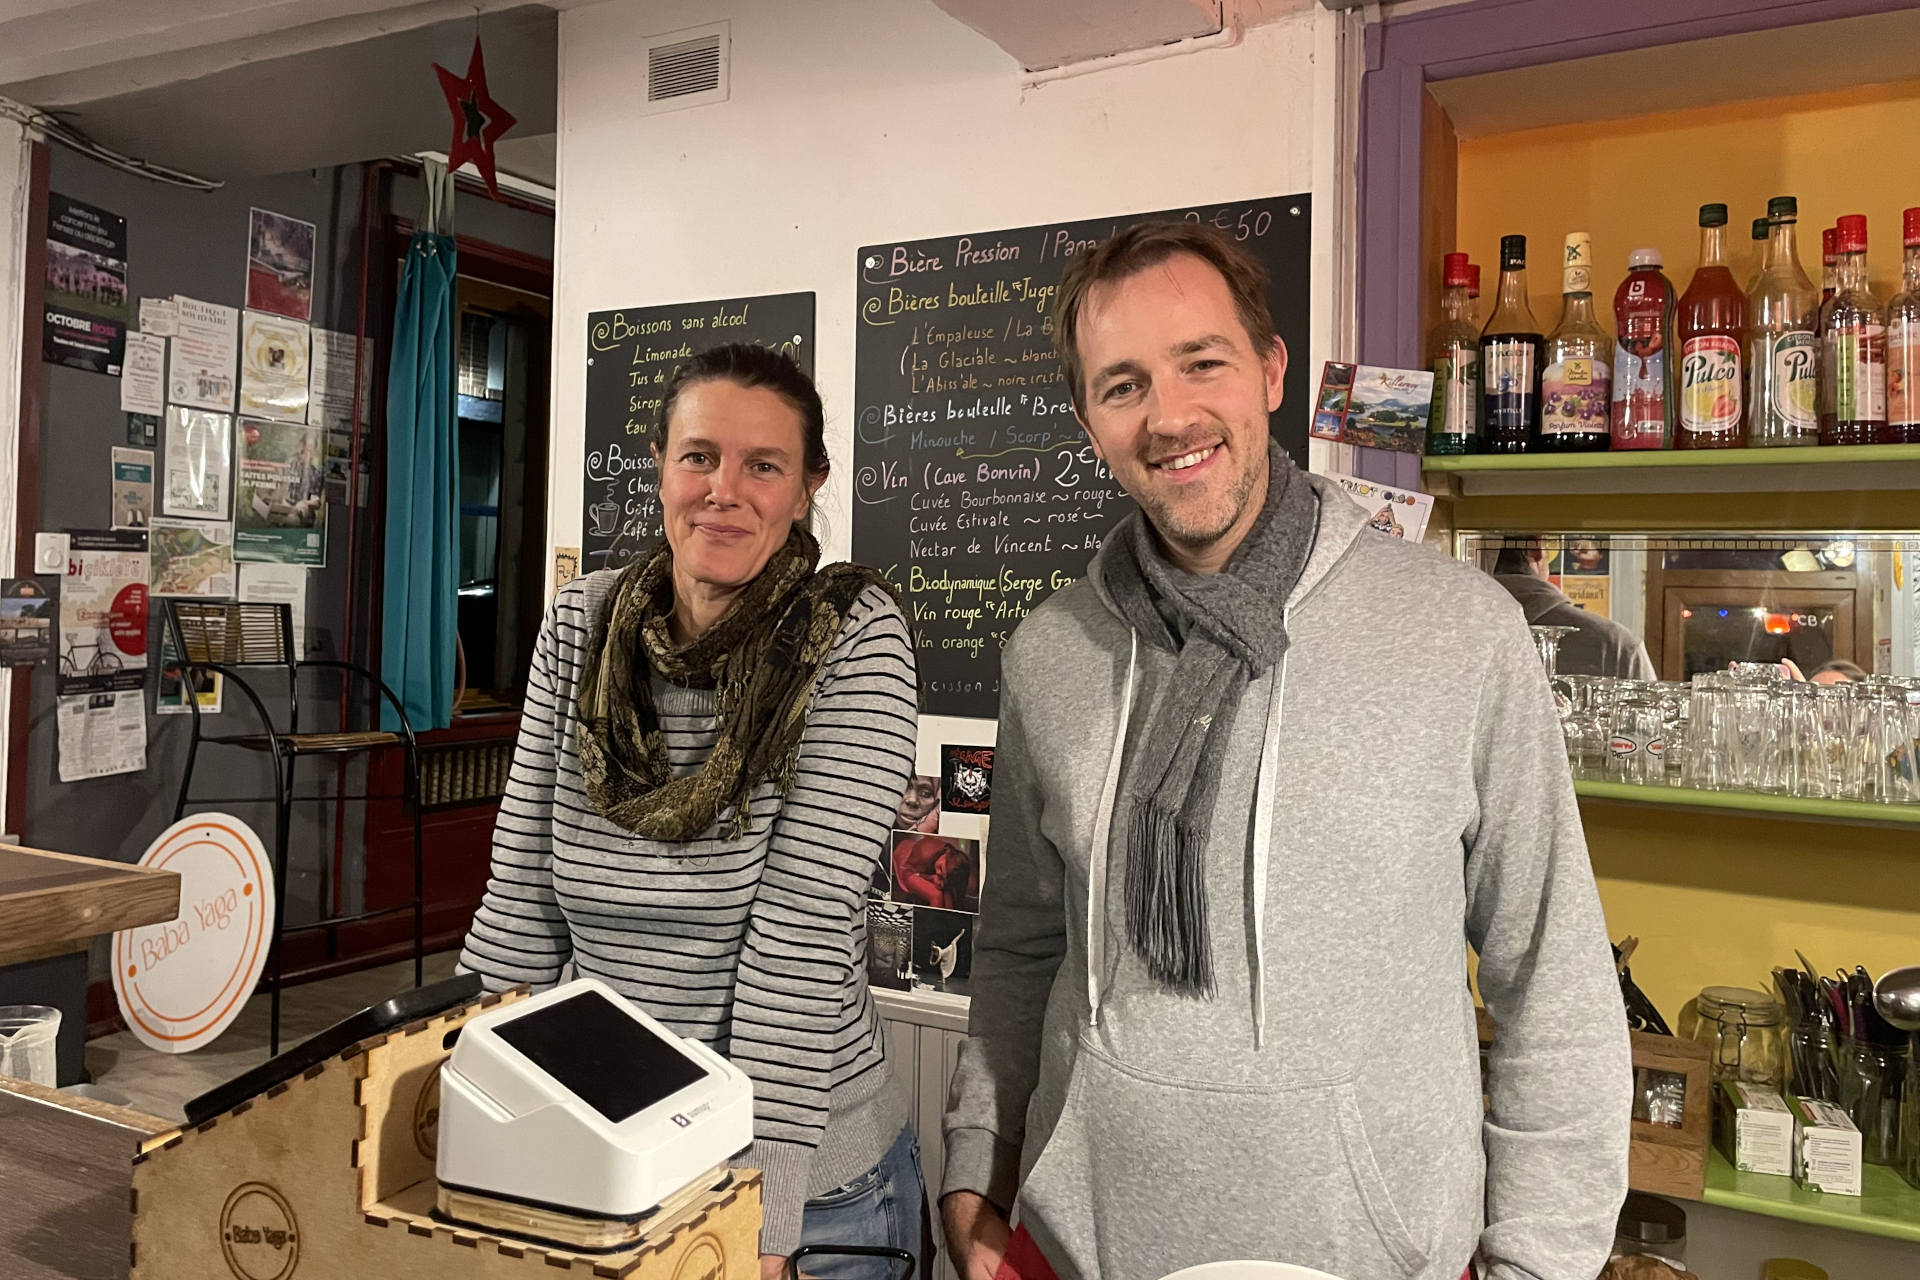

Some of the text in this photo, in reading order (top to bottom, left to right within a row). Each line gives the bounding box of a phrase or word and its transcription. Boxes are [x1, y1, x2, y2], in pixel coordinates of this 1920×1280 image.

[889, 247, 943, 277] Bière
[955, 238, 1021, 267] Pression
[1053, 230, 1098, 257] Pana
[889, 287, 940, 315] Bières
[948, 280, 1011, 308] bouteille
[46, 312, 91, 332] OCTOBRE
[612, 304, 750, 341] Boissons sans alcool
[911, 321, 996, 349] L'Empaleuse
[1016, 319, 1033, 337] La
[632, 342, 693, 366] Limonade
[629, 369, 664, 387] Jus de
[998, 374, 1027, 387] noire
[1685, 355, 1735, 388] Pulco
[629, 395, 662, 416] Sirop
[884, 404, 937, 427] Bières
[947, 396, 1012, 421] bouteille
[910, 430, 977, 450] Minouche
[881, 460, 909, 490] Vin
[910, 488, 1115, 511] Cuvée Bourbonnaise rouge
[623, 520, 648, 541] Café
[909, 506, 1081, 533] Cuvée Estivale rosé
[909, 534, 1101, 559] Nectar de Vincent bla
[909, 565, 997, 604] Biodynamique
[913, 601, 937, 621] Vin
[944, 606, 983, 630] rouge
[914, 628, 934, 650] Vin
[941, 637, 985, 659] orange
[930, 679, 983, 693] cisson
[140, 888, 238, 971] Baba Yaga
[233, 1224, 287, 1250] Baba Yaga
